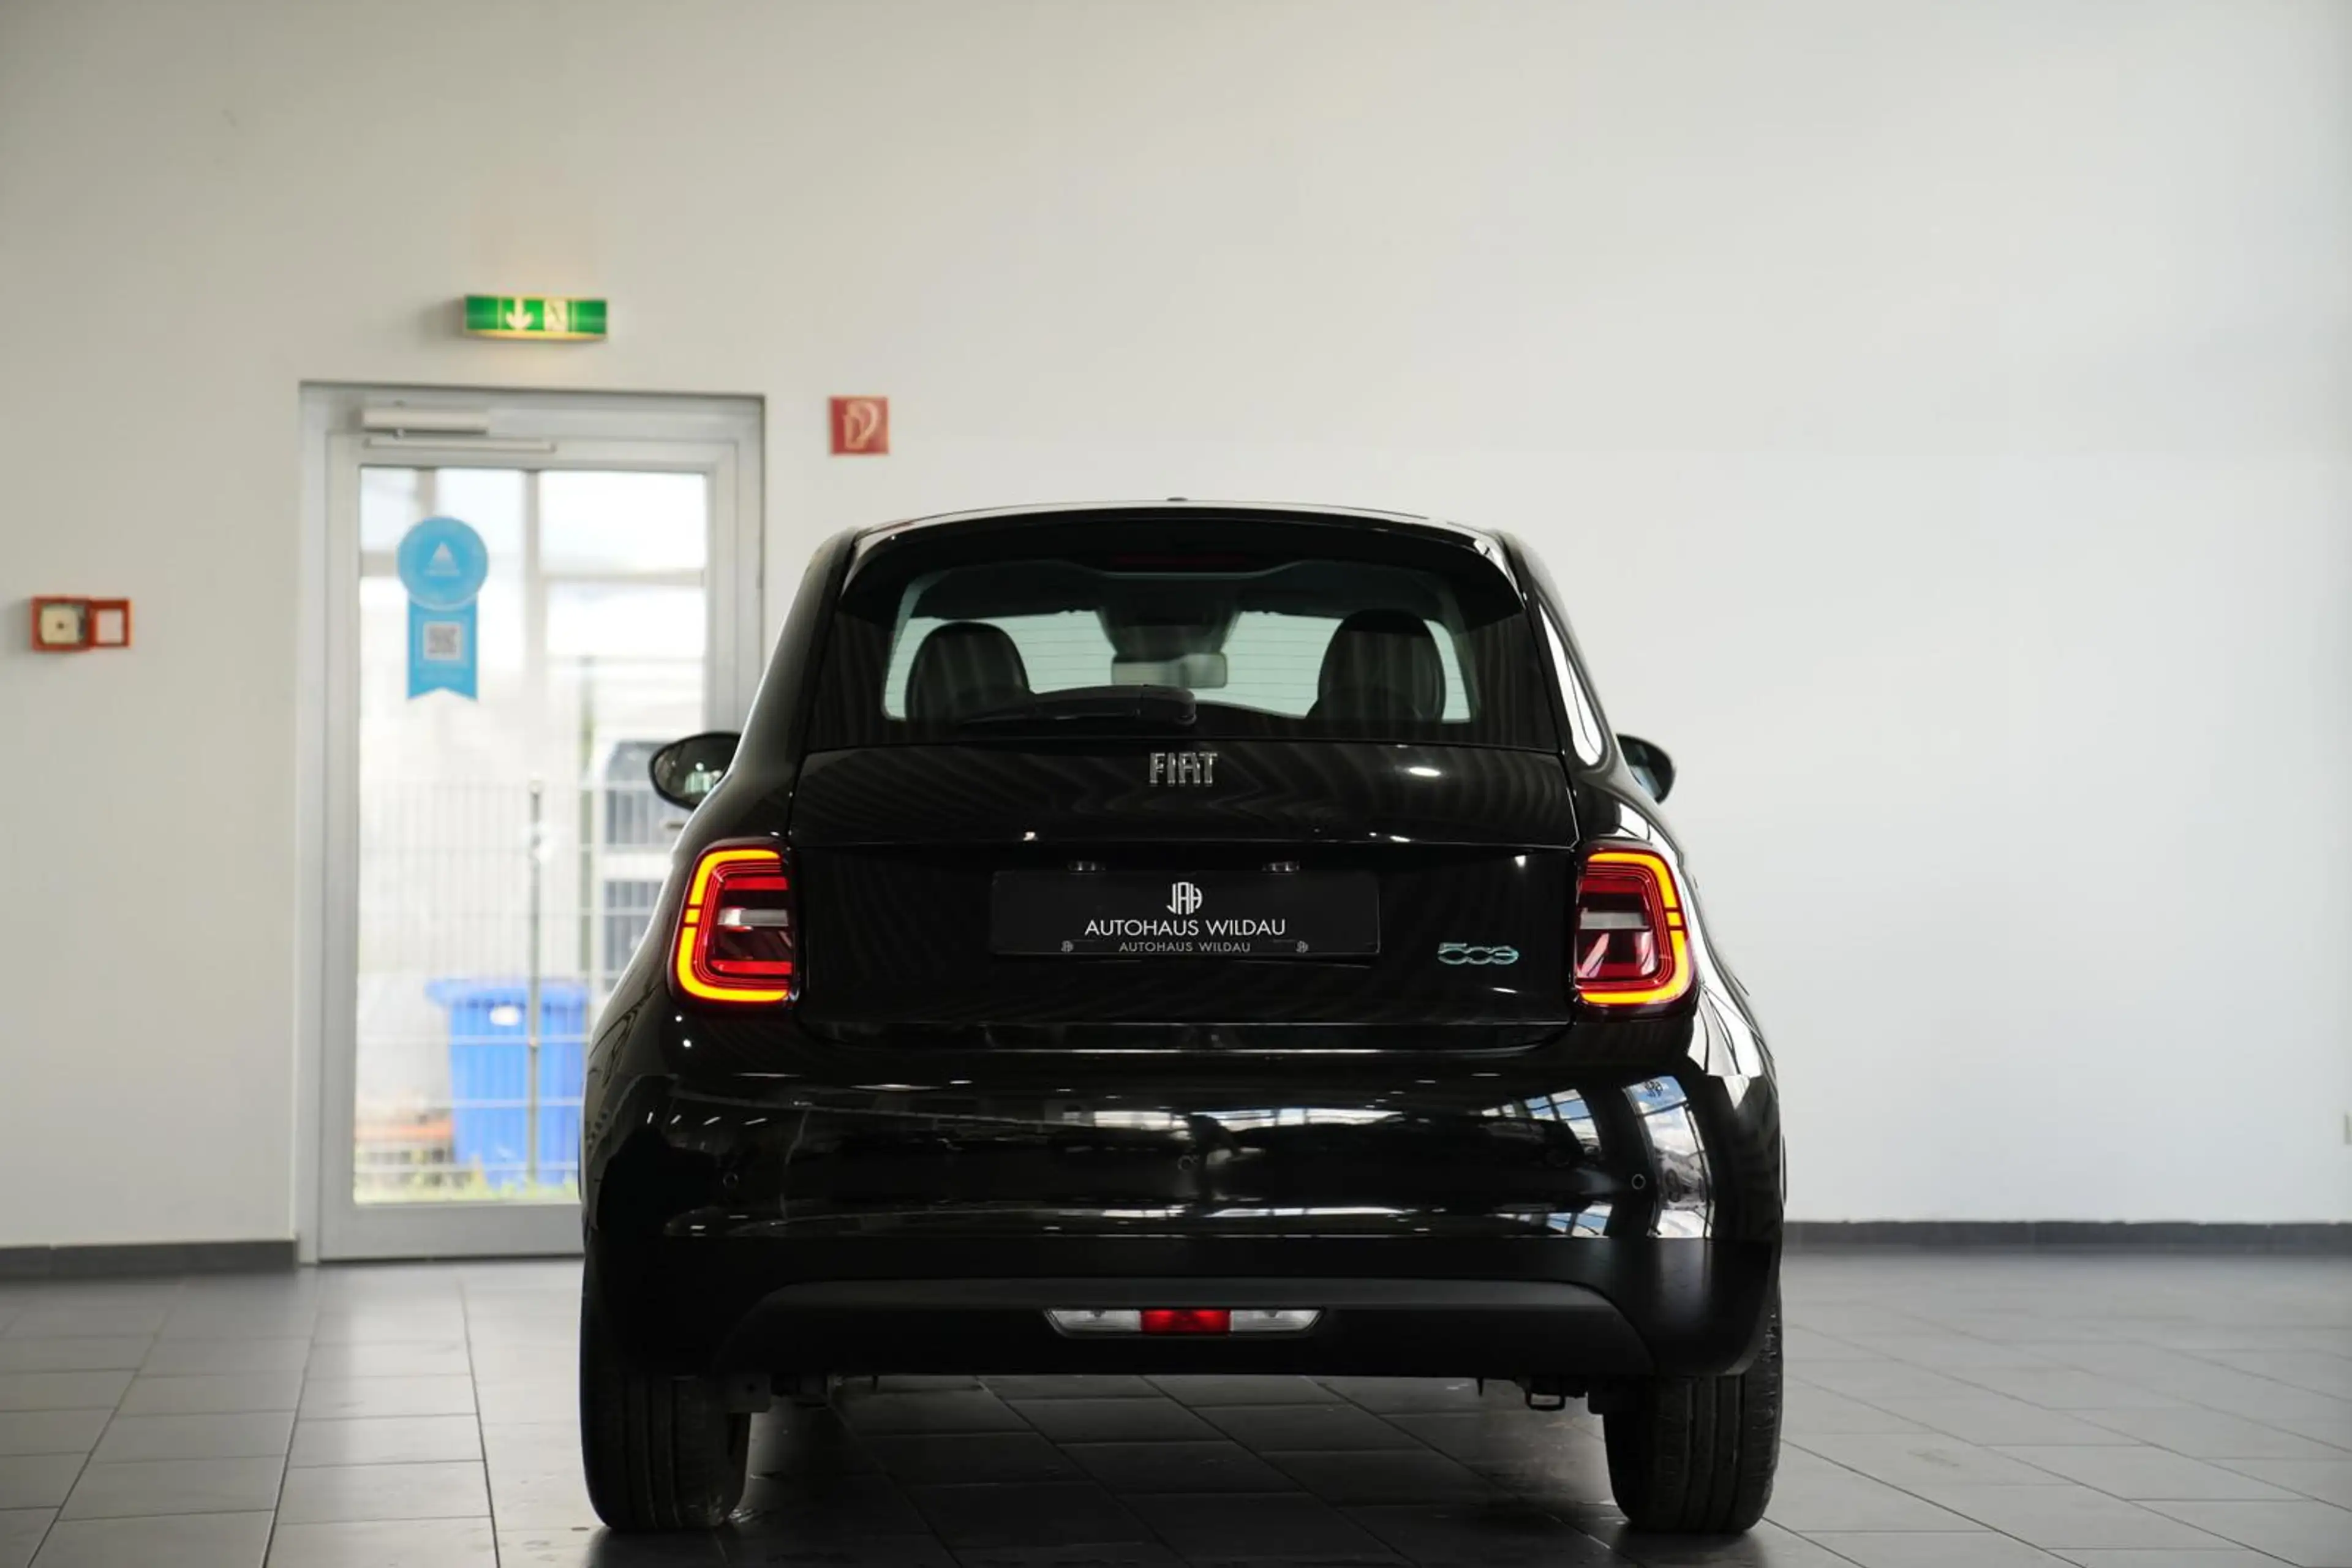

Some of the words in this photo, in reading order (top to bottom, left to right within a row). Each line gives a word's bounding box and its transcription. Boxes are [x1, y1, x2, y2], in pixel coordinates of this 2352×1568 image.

[1149, 752, 1218, 786] FIAT
[1084, 919, 1199, 936] AUTOHAUS
[1205, 919, 1286, 936] WILDAU
[1118, 941, 1193, 952] AUTOHAUS
[1199, 941, 1251, 952] WILDAU
